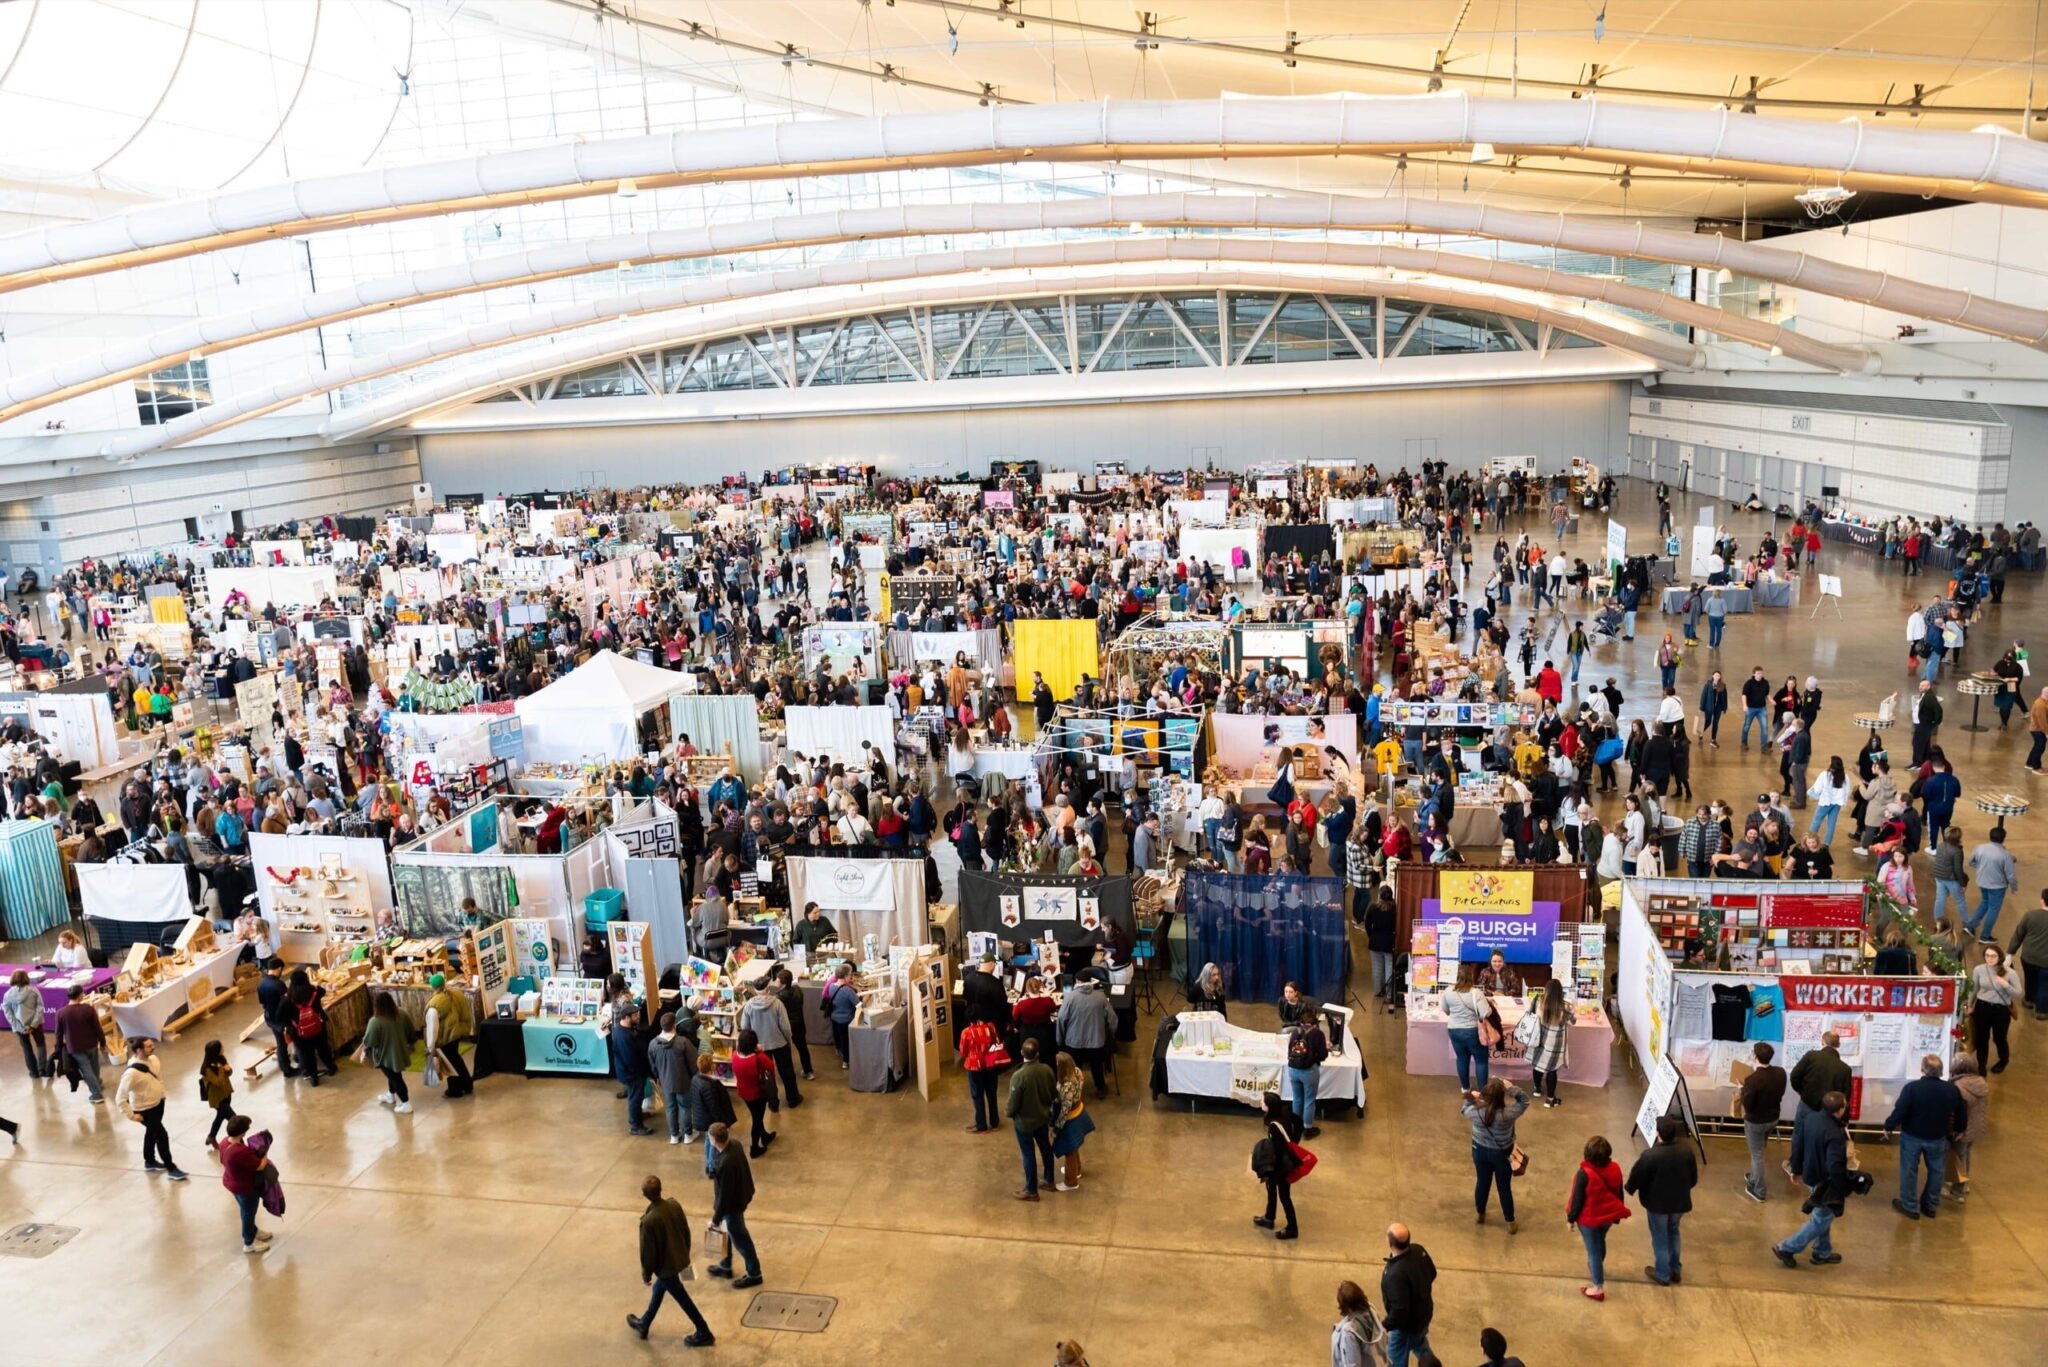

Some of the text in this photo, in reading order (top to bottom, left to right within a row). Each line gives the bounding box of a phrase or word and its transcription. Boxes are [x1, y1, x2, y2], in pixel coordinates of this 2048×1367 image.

[1792, 415, 1810, 429] EXIT
[1795, 984, 1944, 1008] WORKER BIRD
